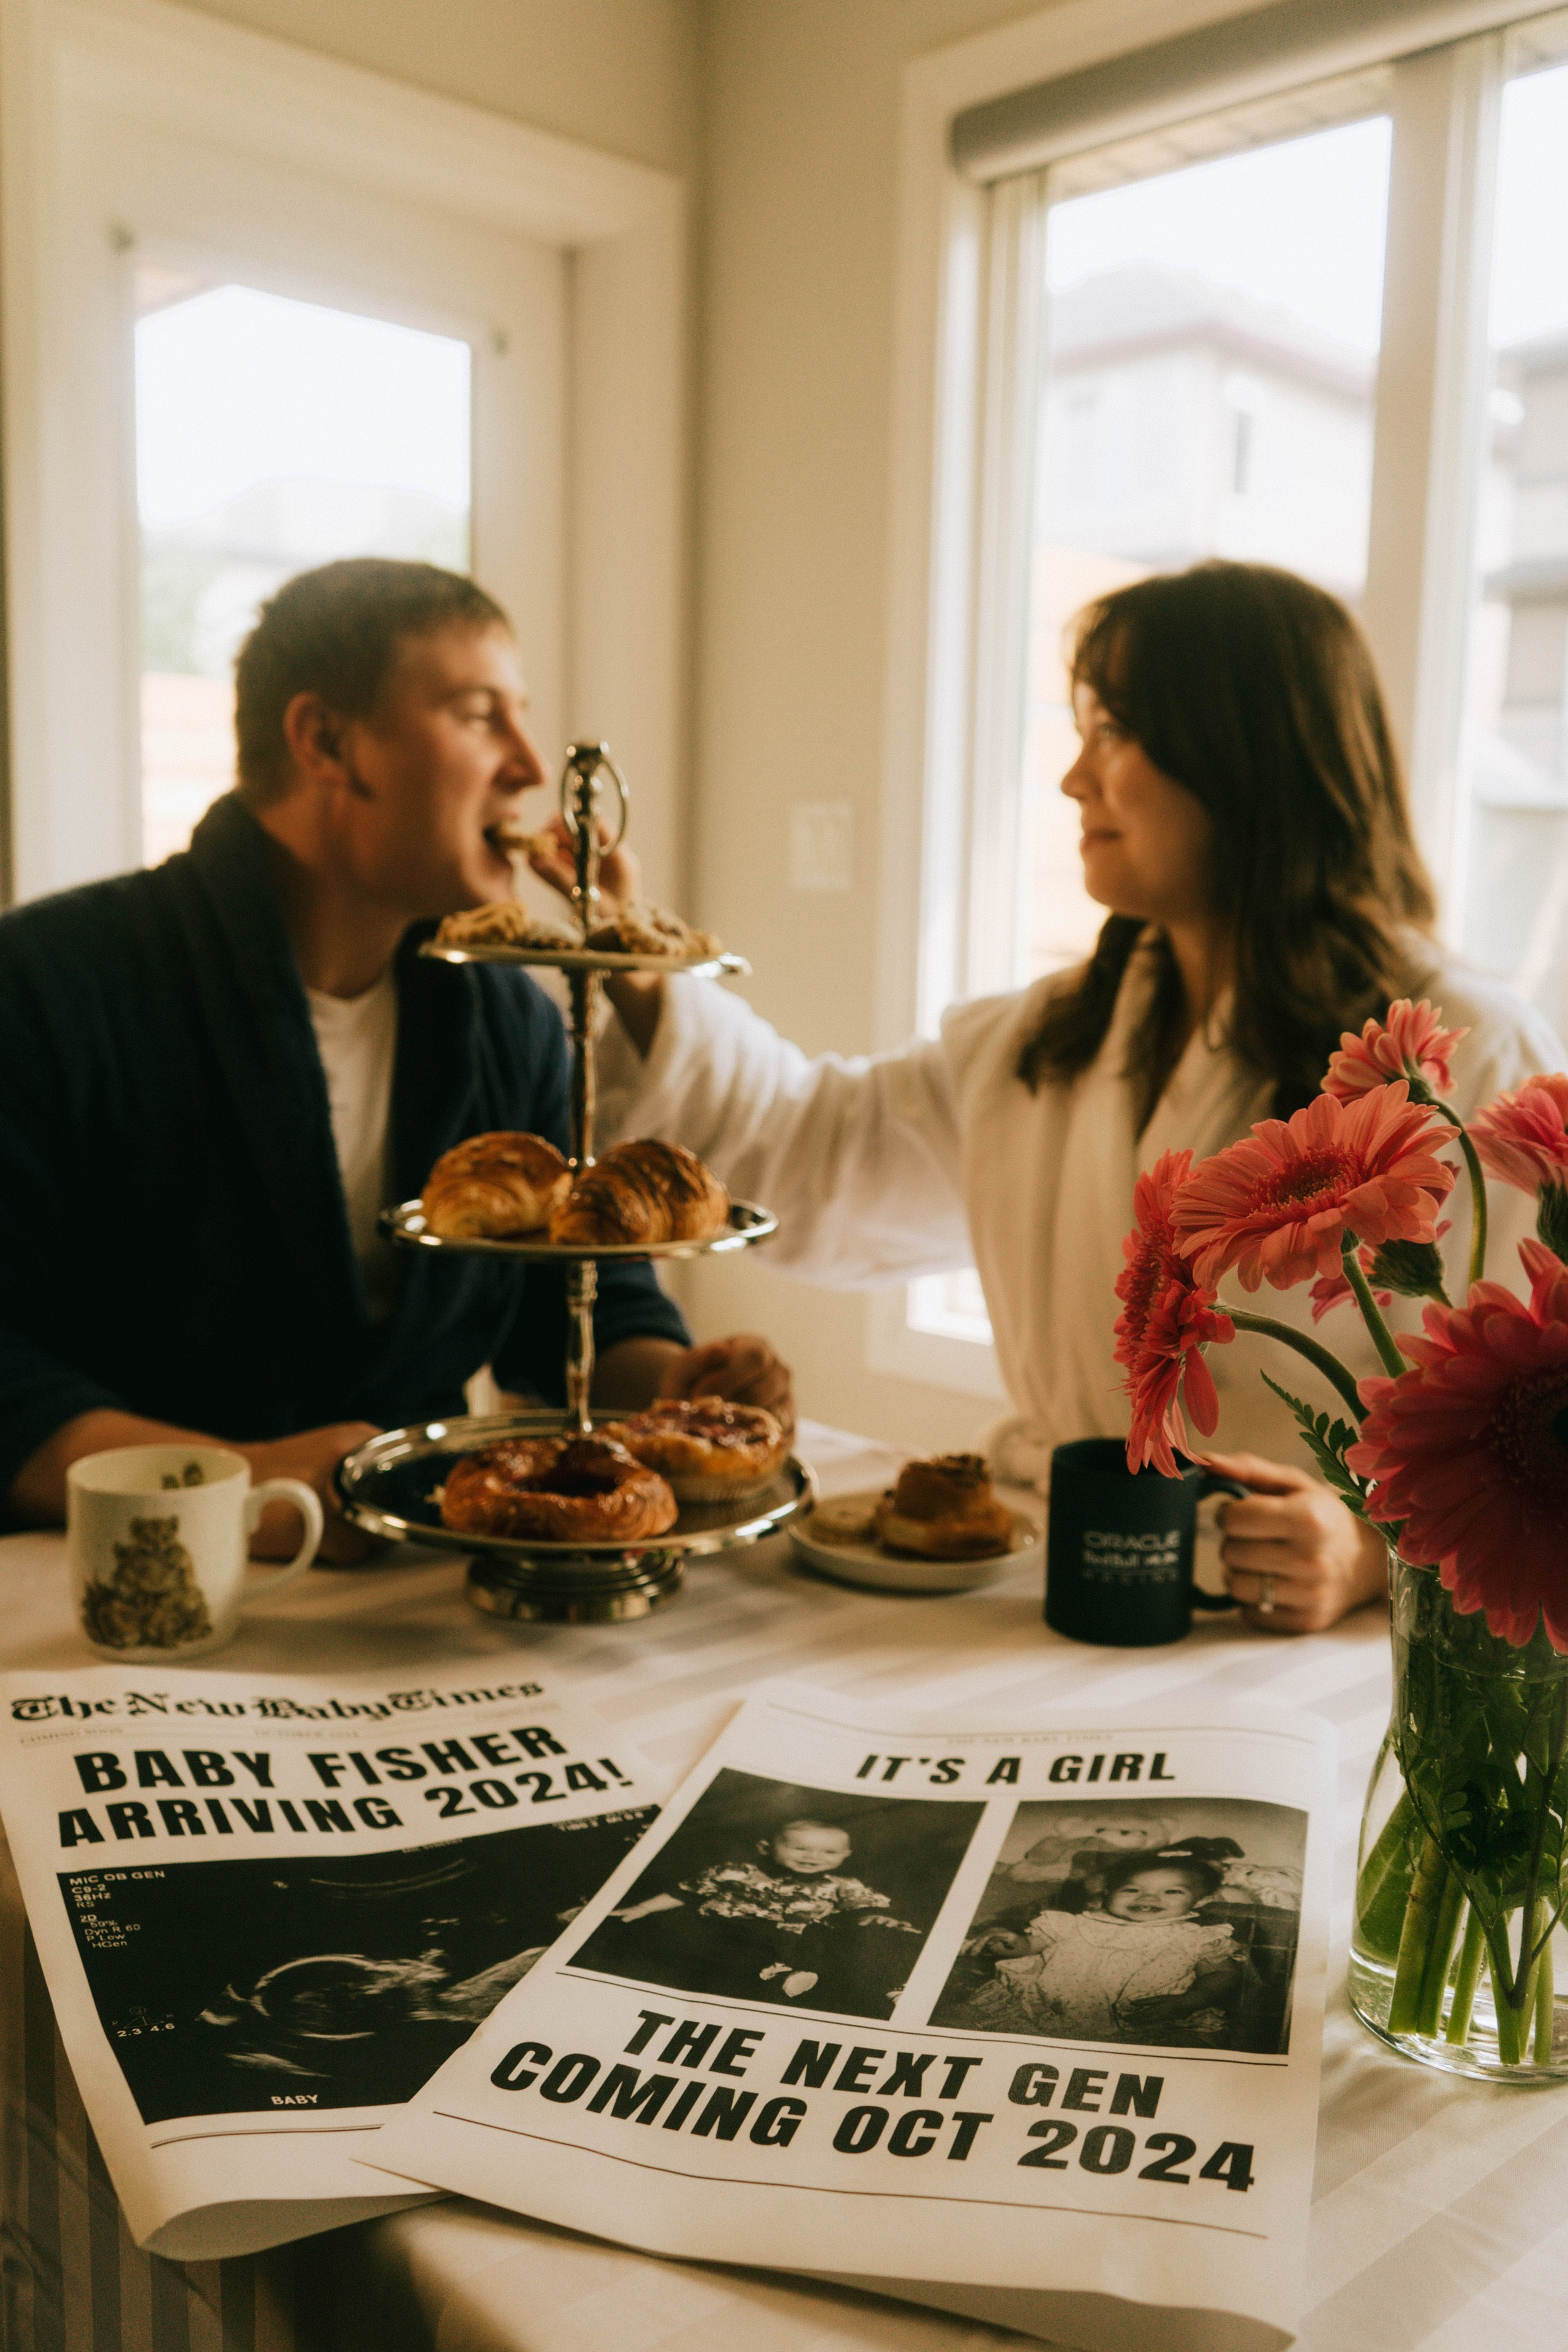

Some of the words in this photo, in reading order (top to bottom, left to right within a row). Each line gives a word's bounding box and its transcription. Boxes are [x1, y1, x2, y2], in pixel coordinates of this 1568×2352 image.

[10, 1694, 117, 1721] The
[122, 1690, 246, 1717] New
[249, 1695, 391, 1721] Baby
[387, 1681, 544, 1713] Times
[74, 1749, 276, 1793] BABY
[306, 1725, 568, 1789] FISHER
[855, 1754, 967, 1784] IT'S
[985, 1756, 1022, 1785] A
[1047, 1752, 1175, 1784] GIRL
[58, 1796, 404, 1848] ARRIVING
[423, 1758, 634, 1819] 2024!
[69, 1875, 99, 1885] MIC
[116, 2027, 142, 2037] 2.3
[149, 2022, 175, 2031] 4.6
[622, 2010, 766, 2078] THE
[779, 2040, 983, 2100] NEXT
[1007, 2063, 1166, 2119] GEN
[272, 2094, 318, 2105] BABY
[489, 2040, 808, 2148] COMING
[832, 2105, 993, 2162] OCT
[1016, 2119, 1256, 2193] 2024
